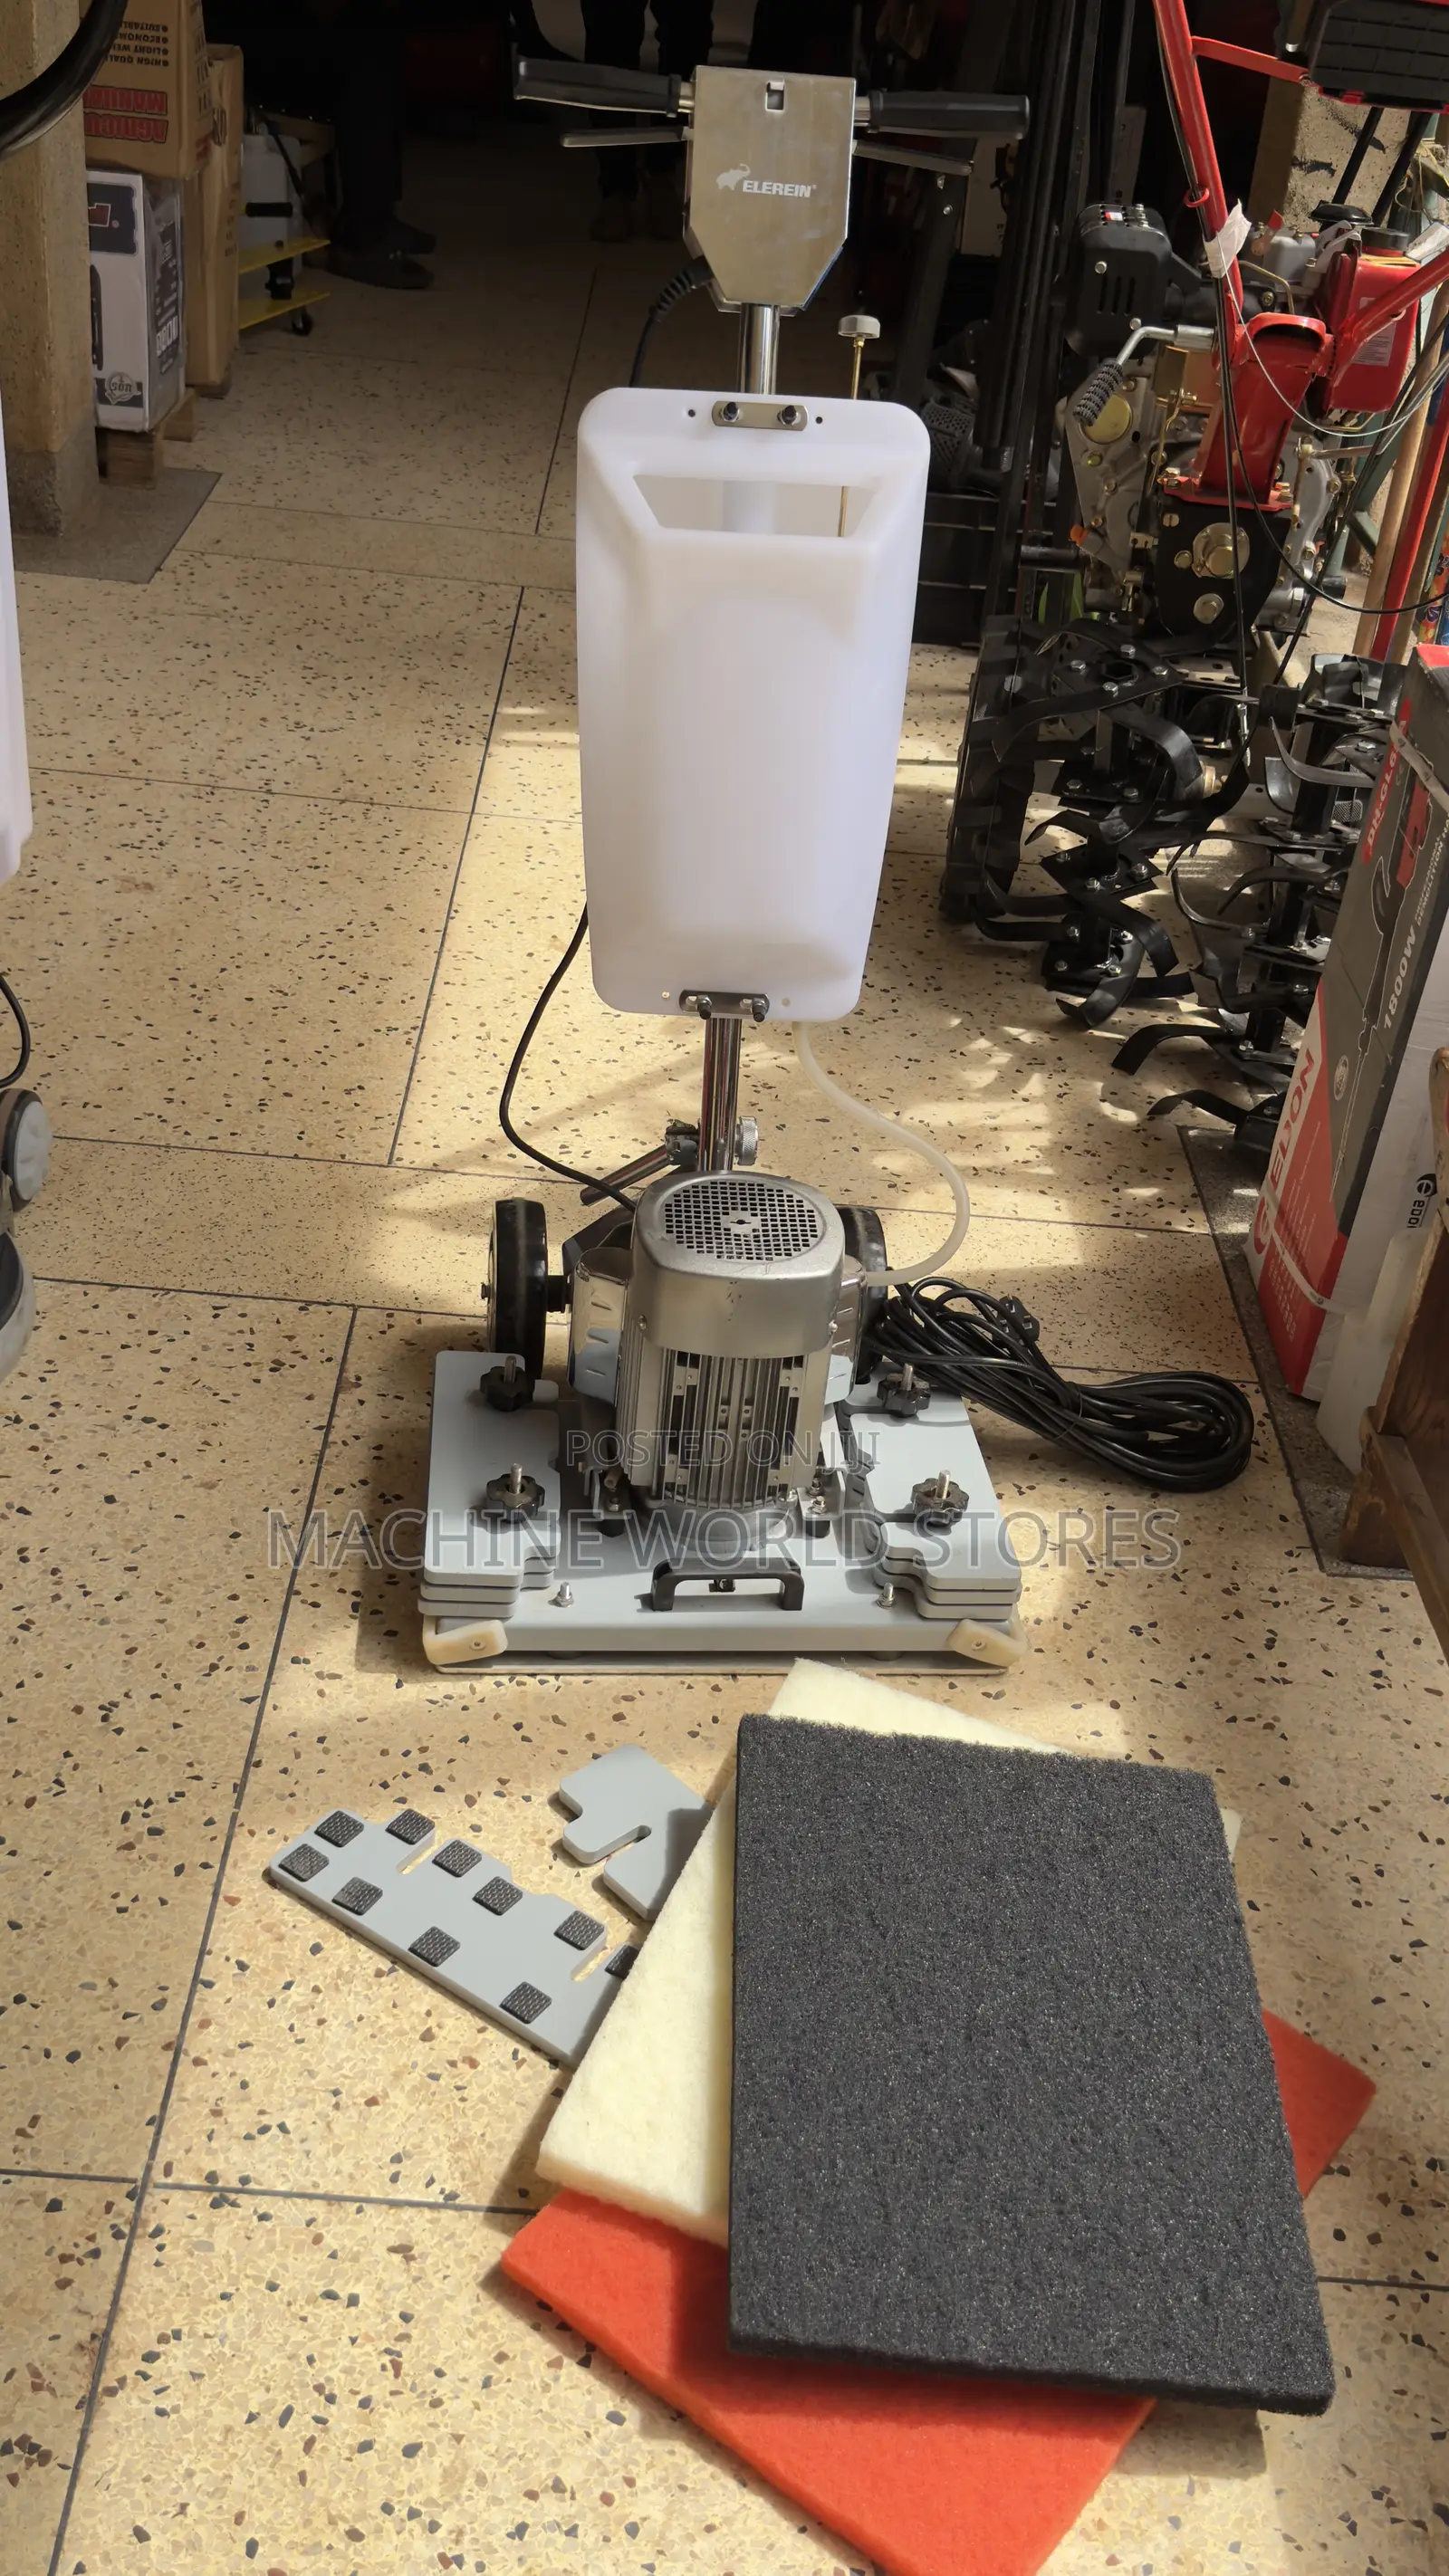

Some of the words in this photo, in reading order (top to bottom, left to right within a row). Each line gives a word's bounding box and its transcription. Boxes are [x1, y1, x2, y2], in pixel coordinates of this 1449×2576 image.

[137, 59, 162, 67] HIGH
[743, 179, 811, 198] ELEREIN
[1416, 840, 1444, 927] DEMOLITION
[1384, 924, 1416, 1029] 1800W
